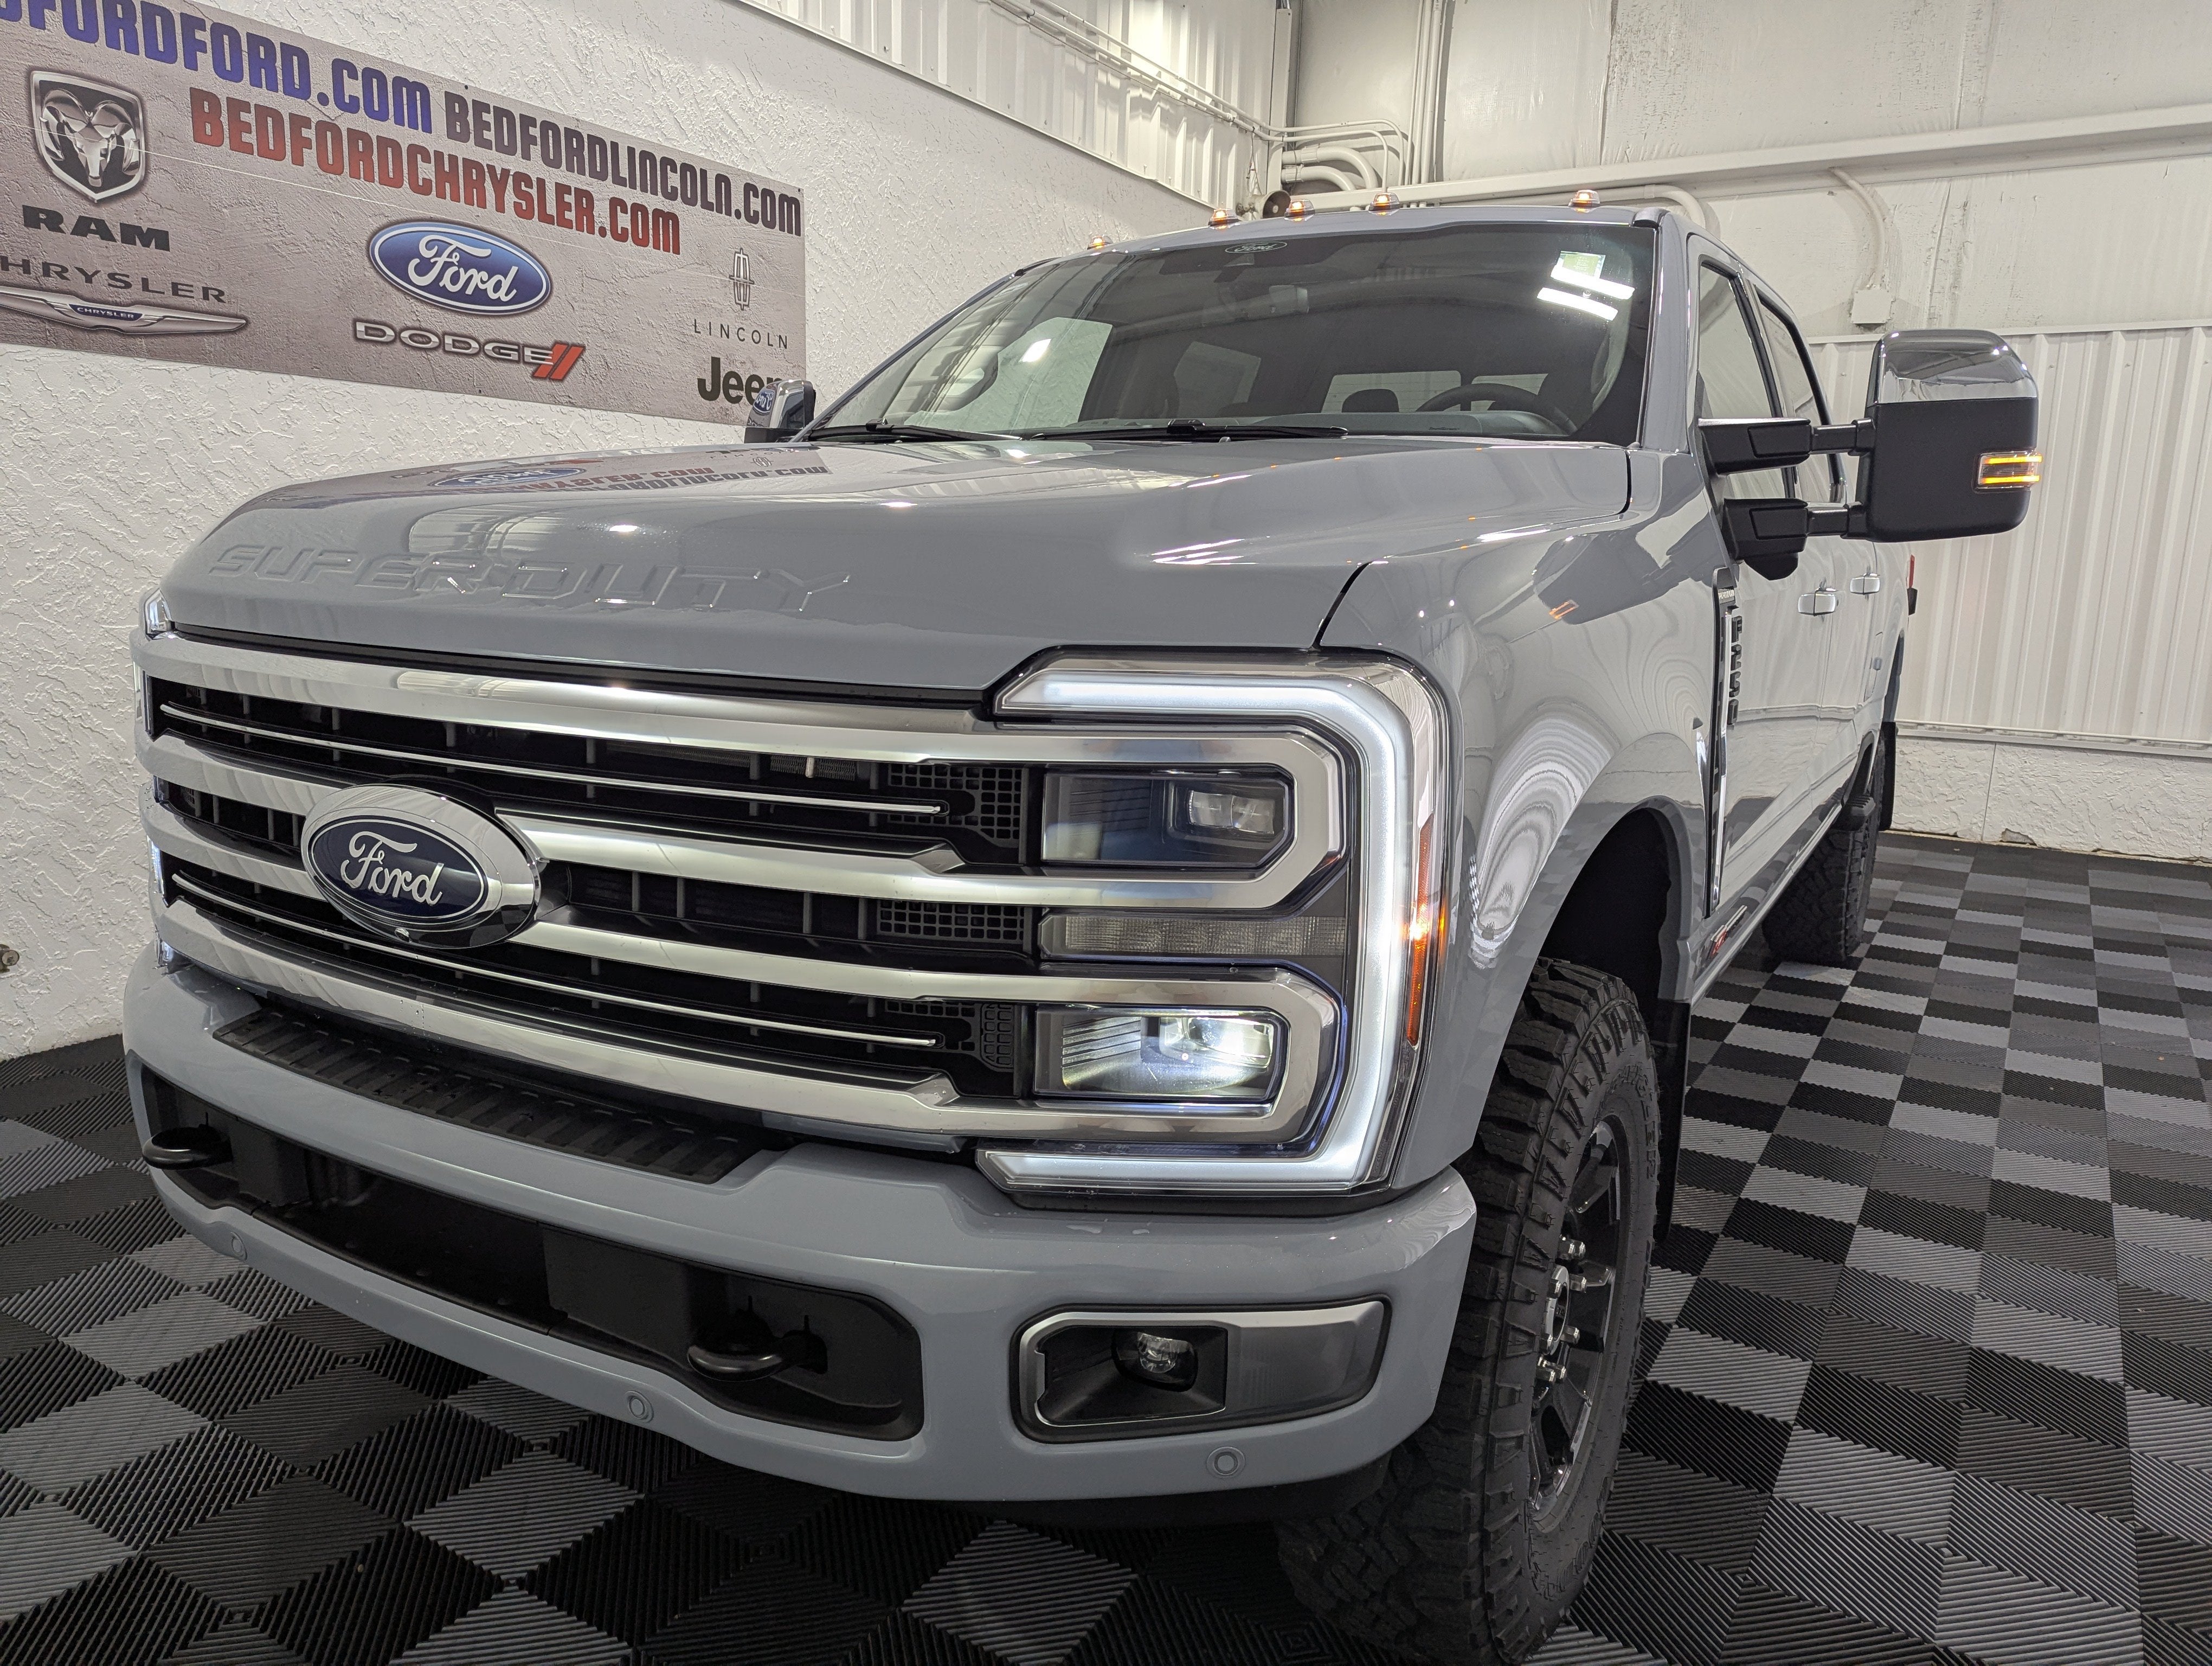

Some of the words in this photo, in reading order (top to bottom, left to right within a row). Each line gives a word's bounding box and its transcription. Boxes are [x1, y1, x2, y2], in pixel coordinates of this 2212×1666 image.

[189, 87, 680, 255] BEDFORDCHRYSLER.COM
[22, 204, 170, 252] RAM
[1234, 242, 1277, 252] Ford
[408, 235, 519, 302] Ford
[77, 307, 135, 319] CHRYSLER
[694, 319, 787, 349] LINCOLN
[356, 321, 554, 365] DODGE
[697, 356, 783, 406] Jee
[209, 544, 493, 595] SUPER
[501, 556, 851, 612] DUTY
[340, 831, 445, 907] Ford
